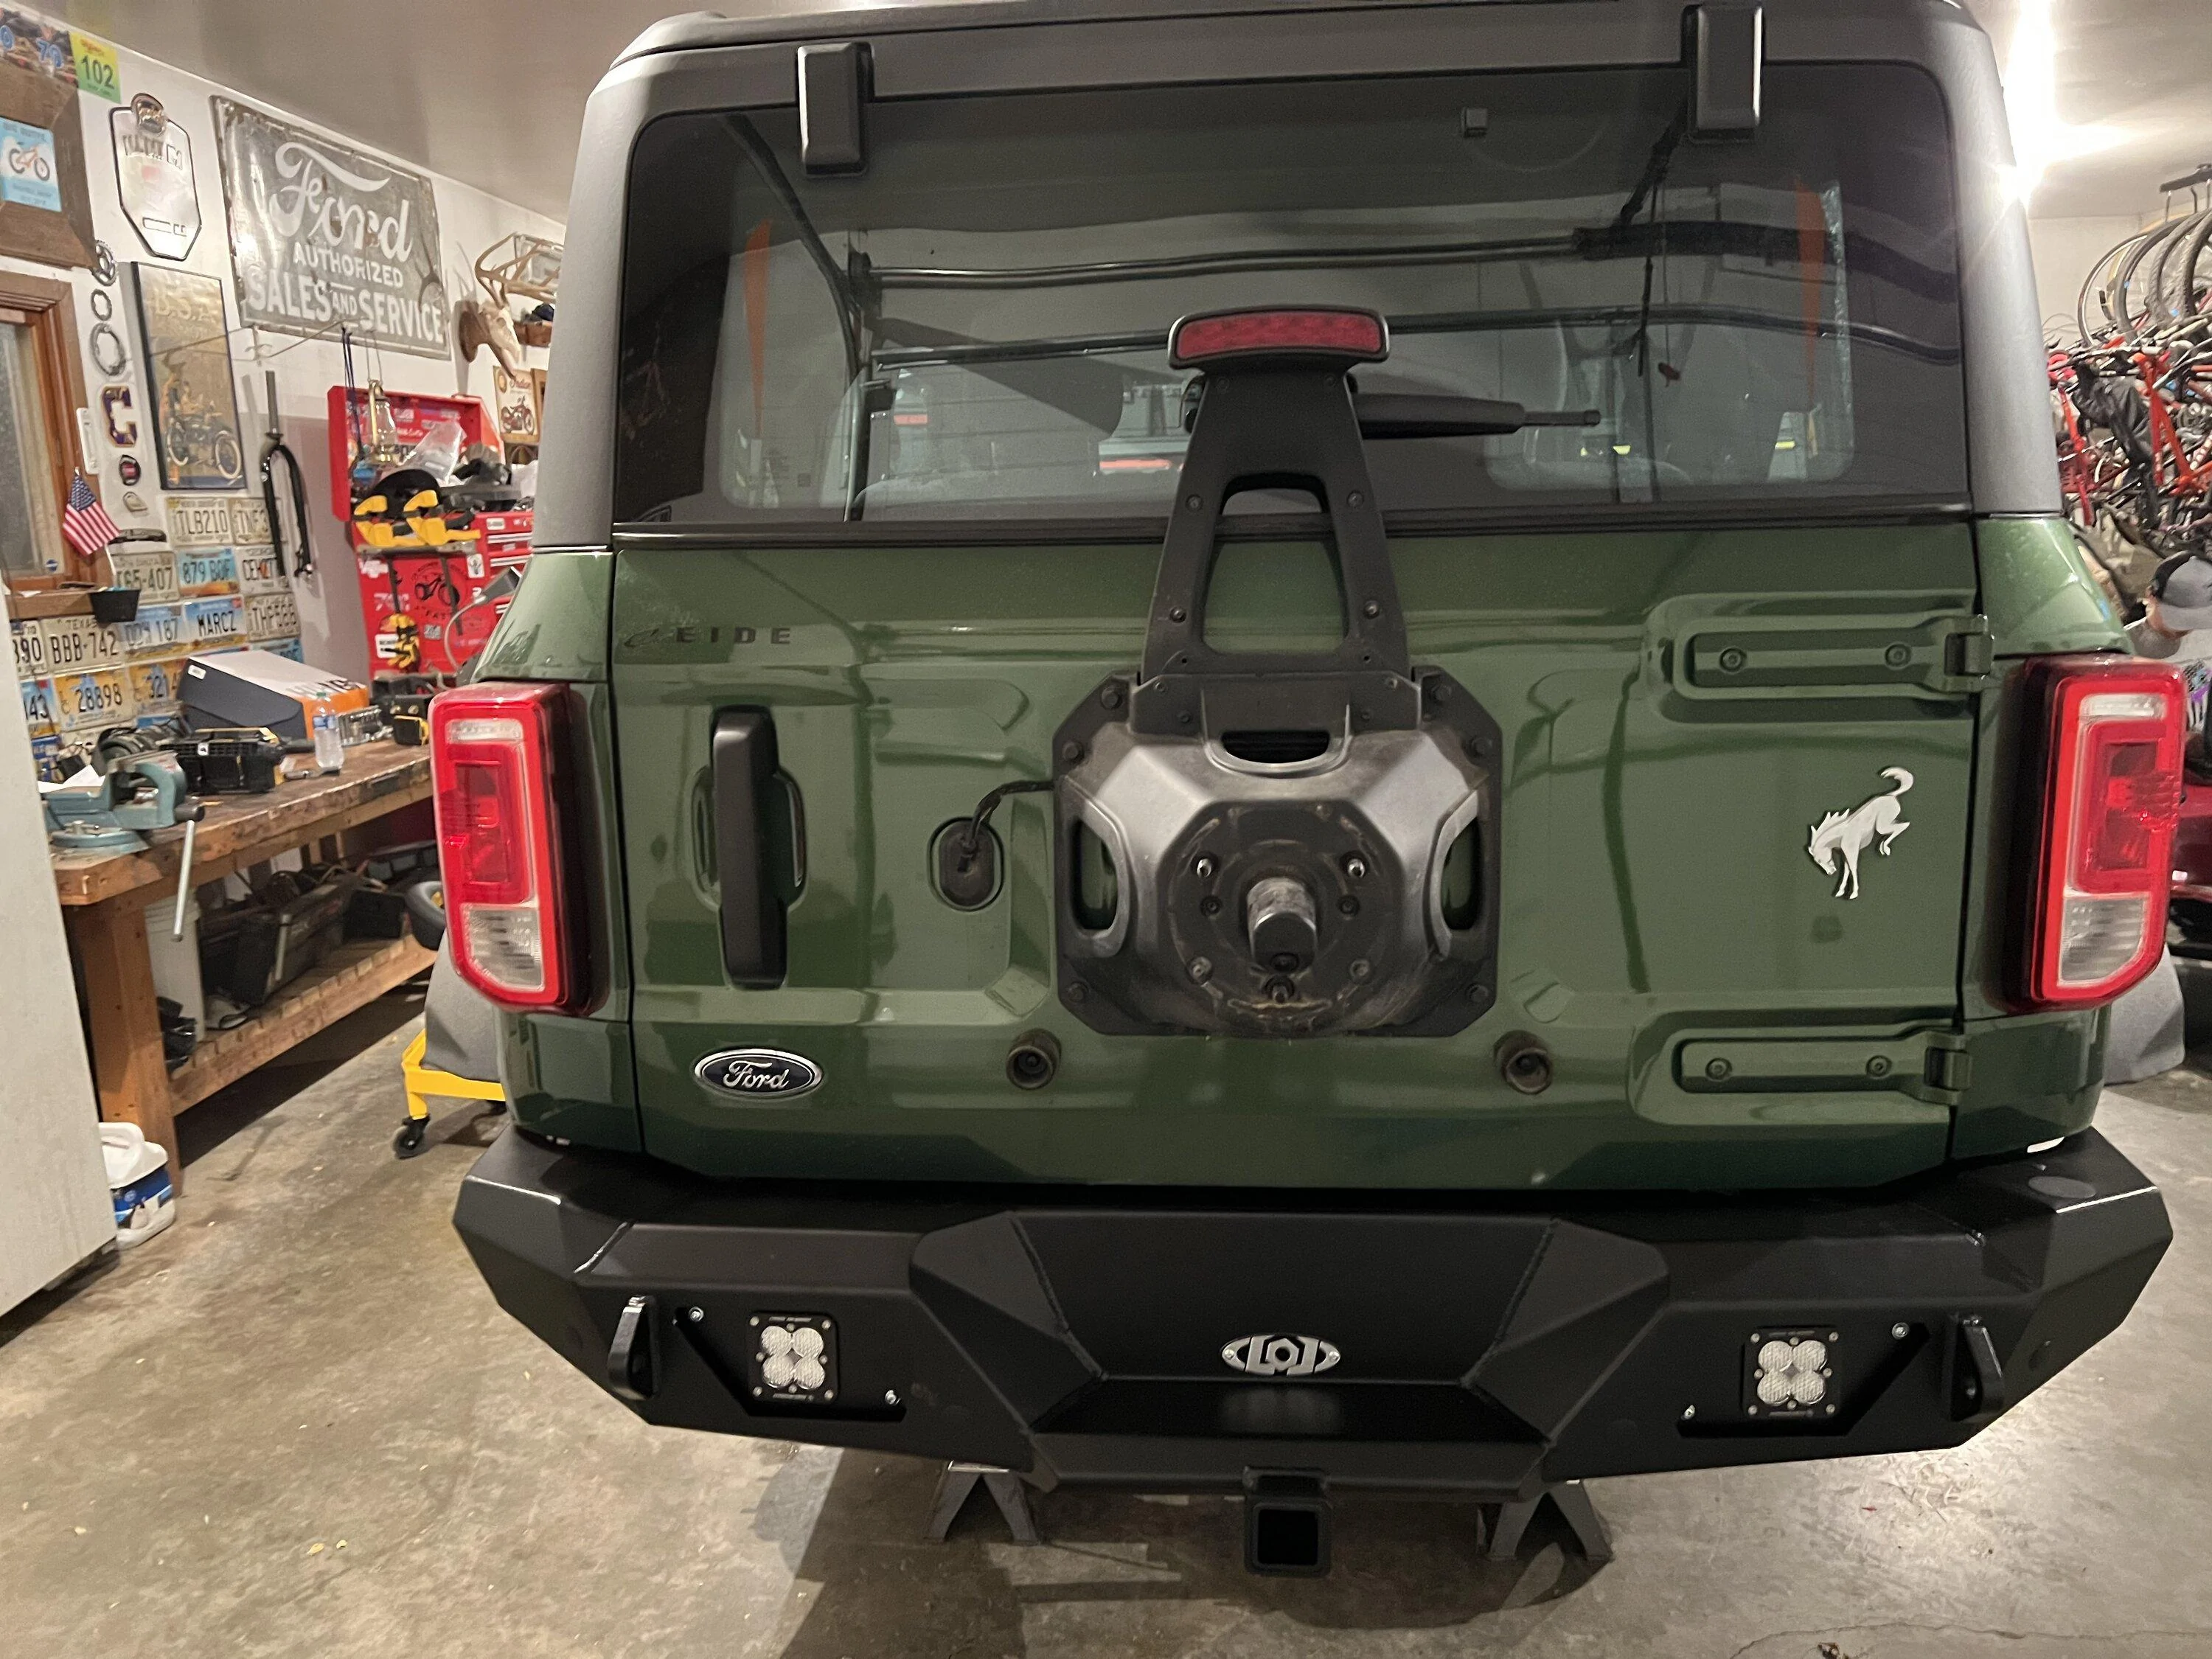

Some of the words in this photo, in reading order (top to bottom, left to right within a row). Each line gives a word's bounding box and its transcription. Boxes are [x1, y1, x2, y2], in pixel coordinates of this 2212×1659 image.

[81, 54, 115, 90] 102
[269, 141, 413, 262] Ford
[293, 241, 404, 288] AUTHORIZED
[247, 265, 332, 323] SALES
[332, 291, 358, 316] AND
[358, 288, 444, 344] SERVICE
[183, 561, 206, 584] 879
[49, 630, 119, 664] BBB-742
[675, 627, 791, 644] EIDE
[75, 682, 122, 713] 28898
[723, 1060, 790, 1089] Ford
